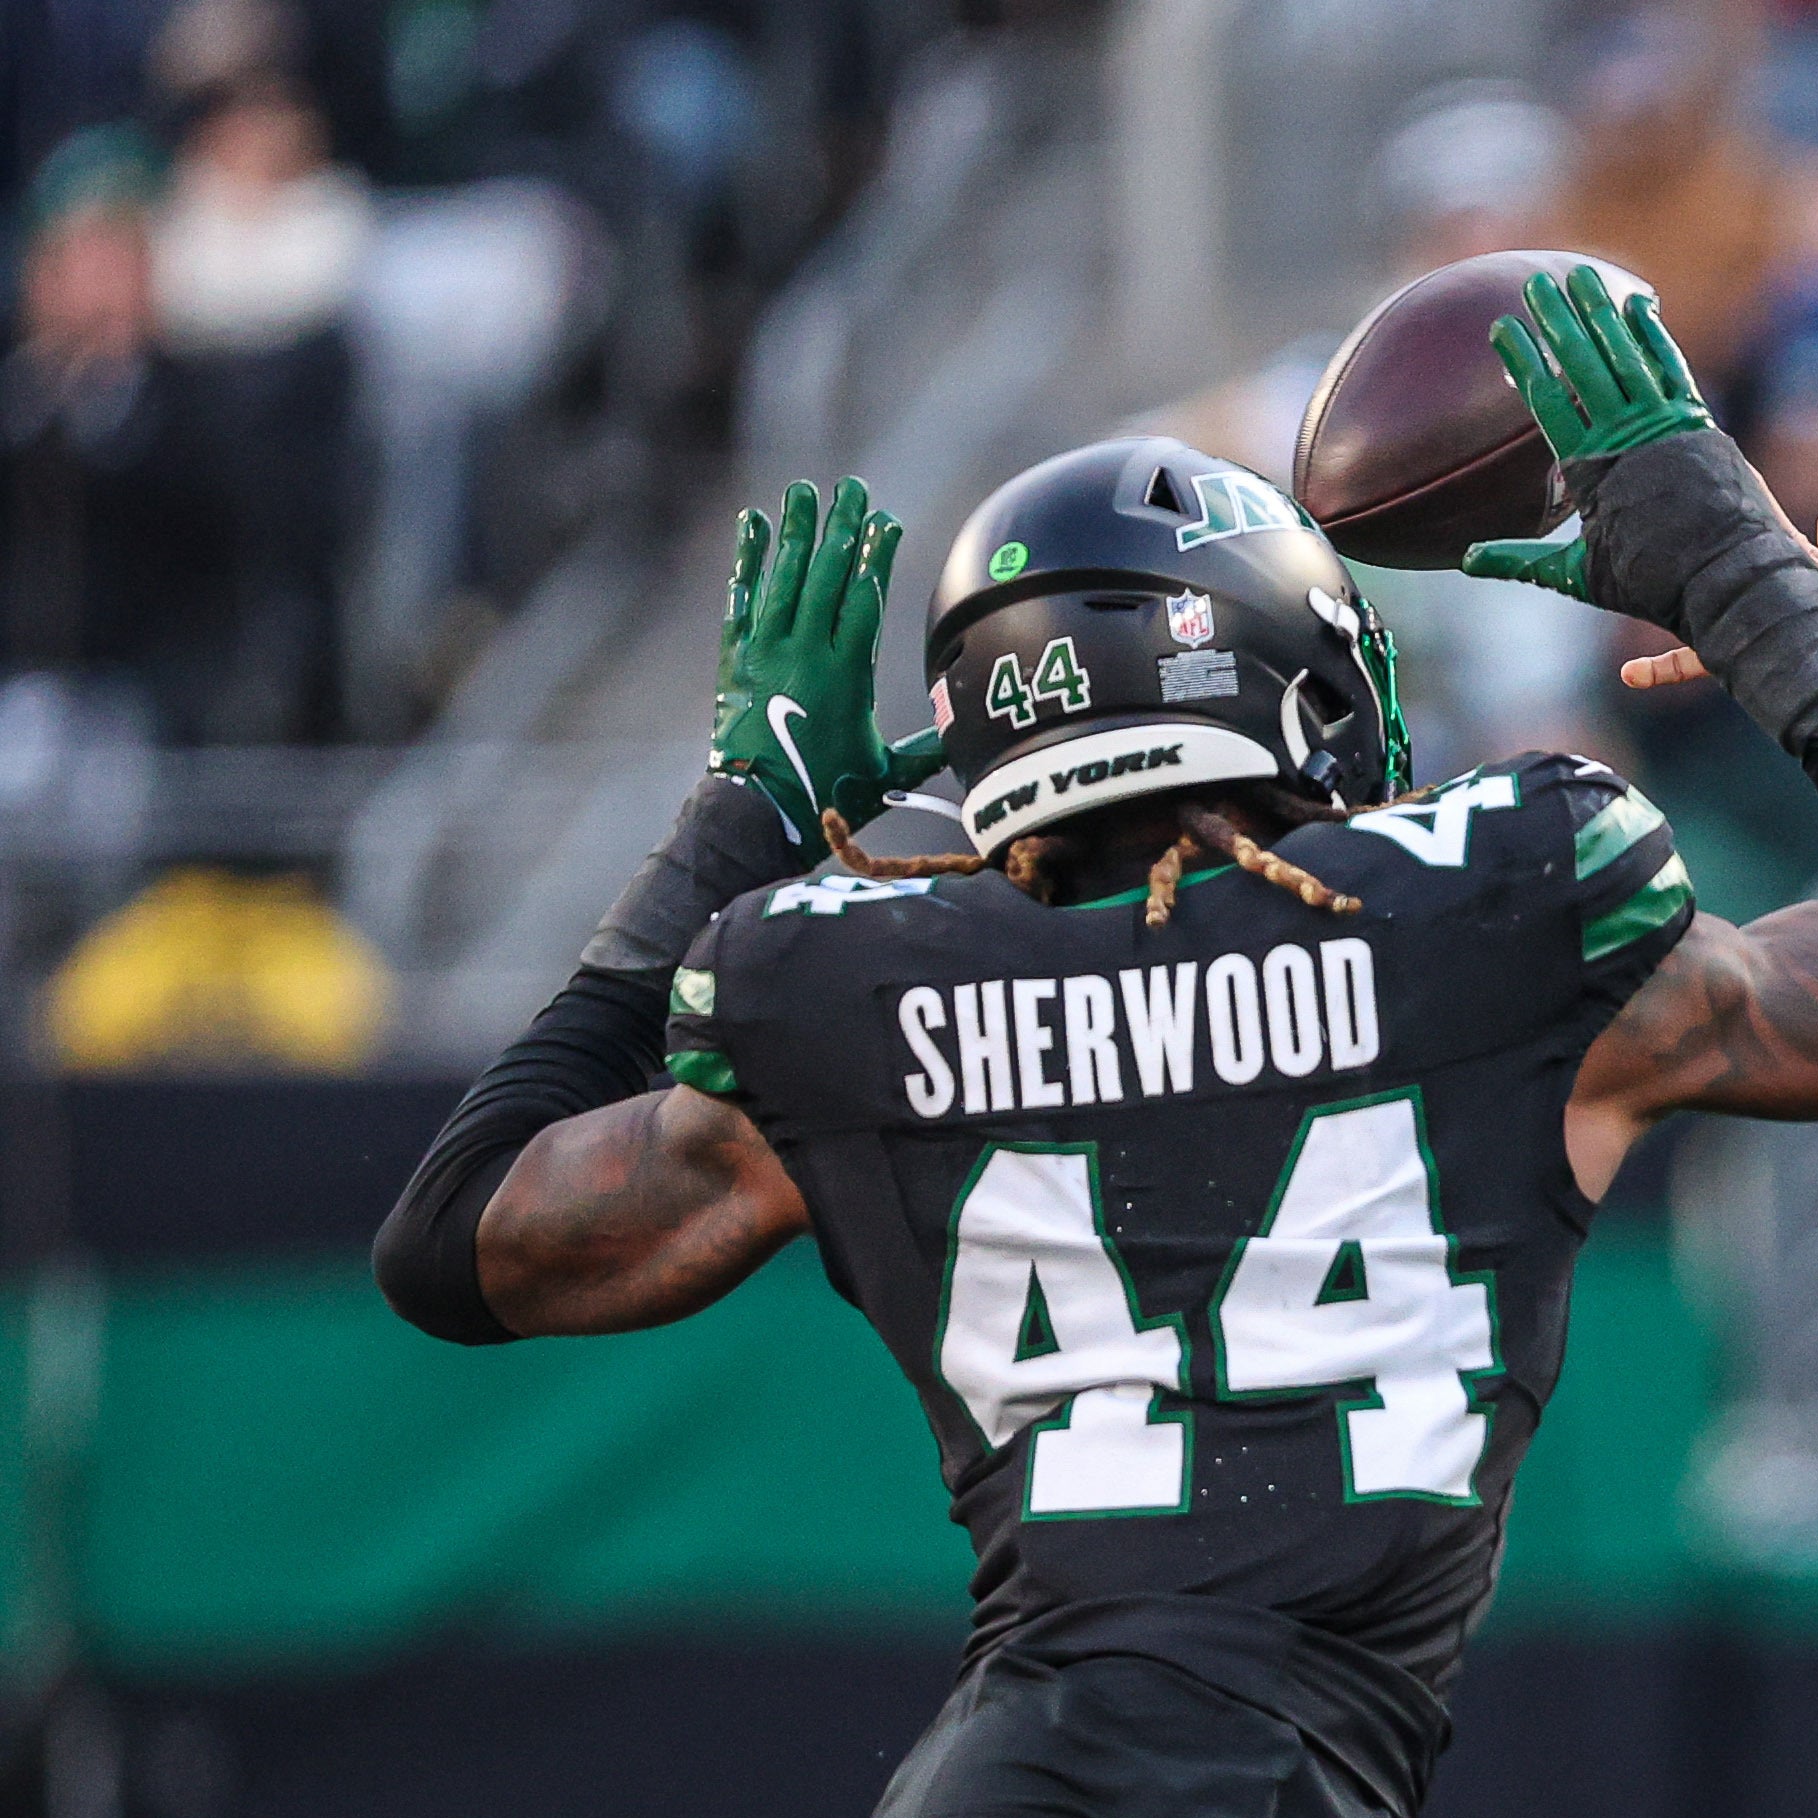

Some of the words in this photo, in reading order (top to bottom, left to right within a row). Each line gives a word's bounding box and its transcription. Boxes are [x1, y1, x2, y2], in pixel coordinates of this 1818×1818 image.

[986, 636, 1092, 730] 44
[973, 779, 1040, 835] NEW
[1049, 743, 1184, 795] YORK
[897, 937, 1380, 1120] SHERWOOD
[938, 1085, 1505, 1521] 44
